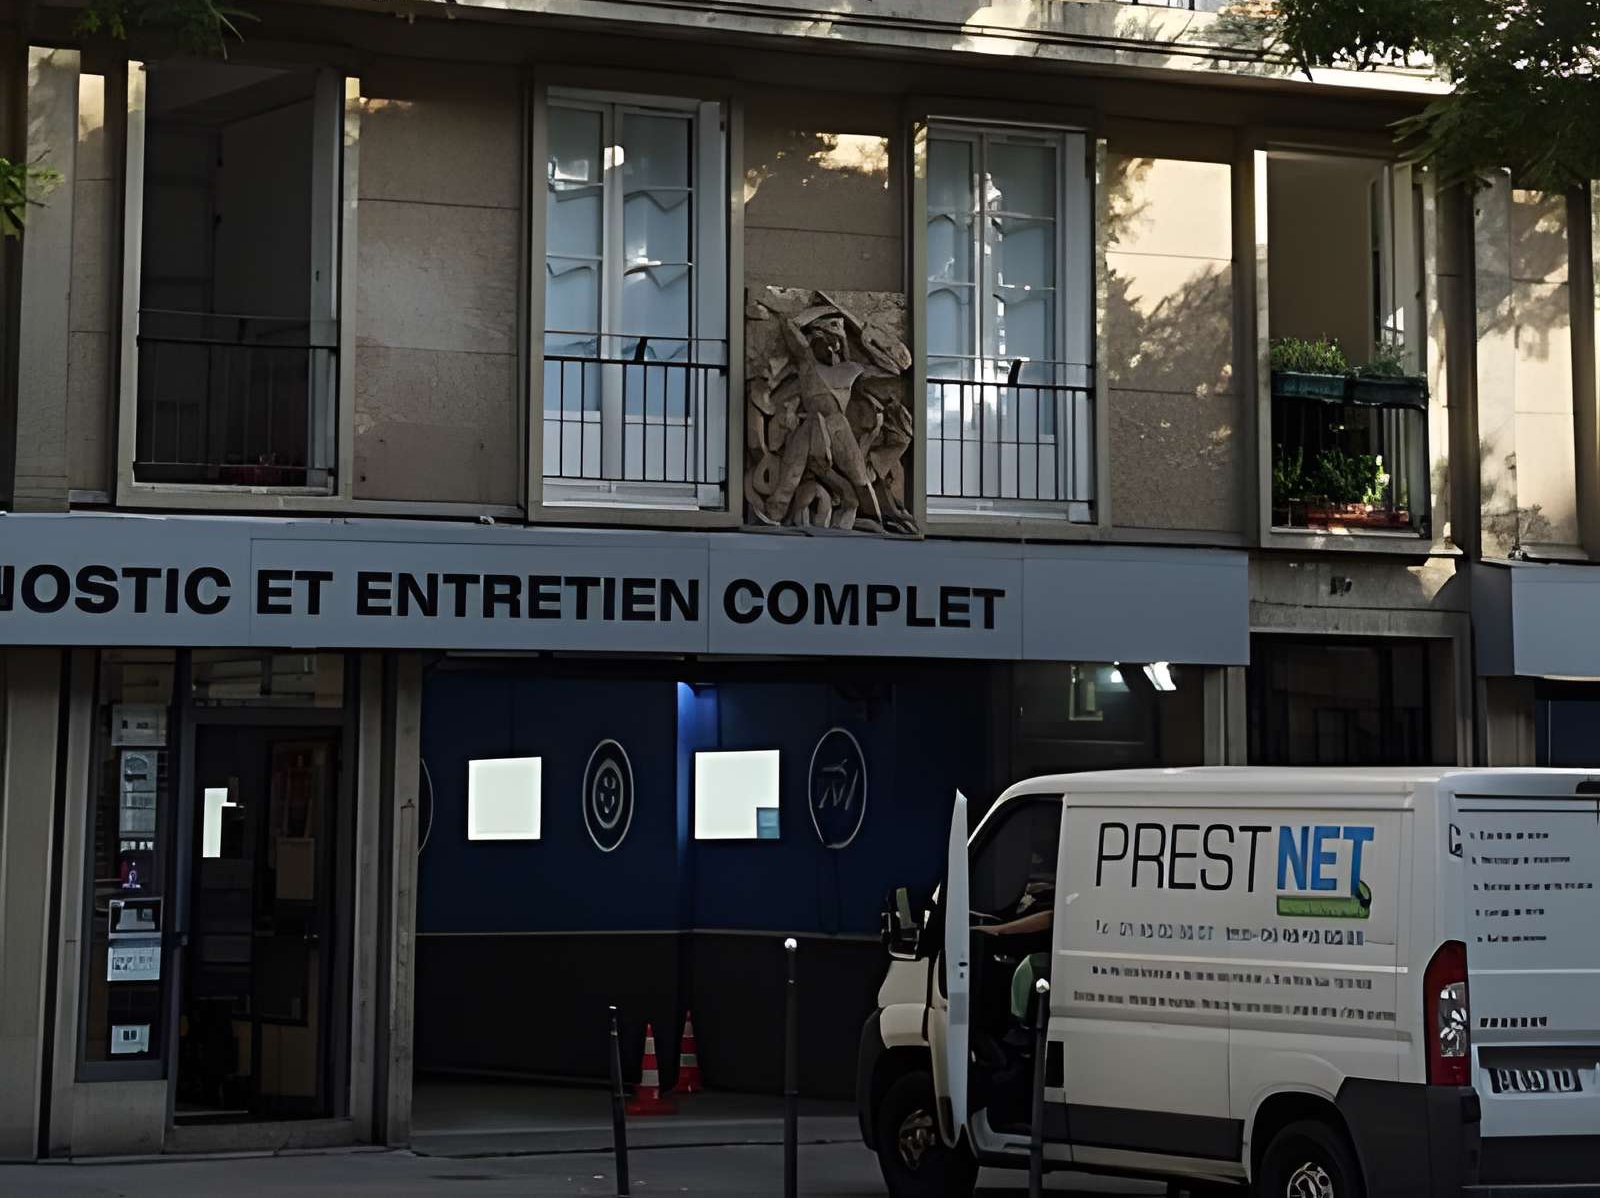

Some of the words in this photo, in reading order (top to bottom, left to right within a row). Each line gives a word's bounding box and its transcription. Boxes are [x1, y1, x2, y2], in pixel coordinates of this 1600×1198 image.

[256, 569, 334, 616] ET
[356, 570, 700, 622] ENTRETIEN
[722, 577, 1006, 630] COMPLET
